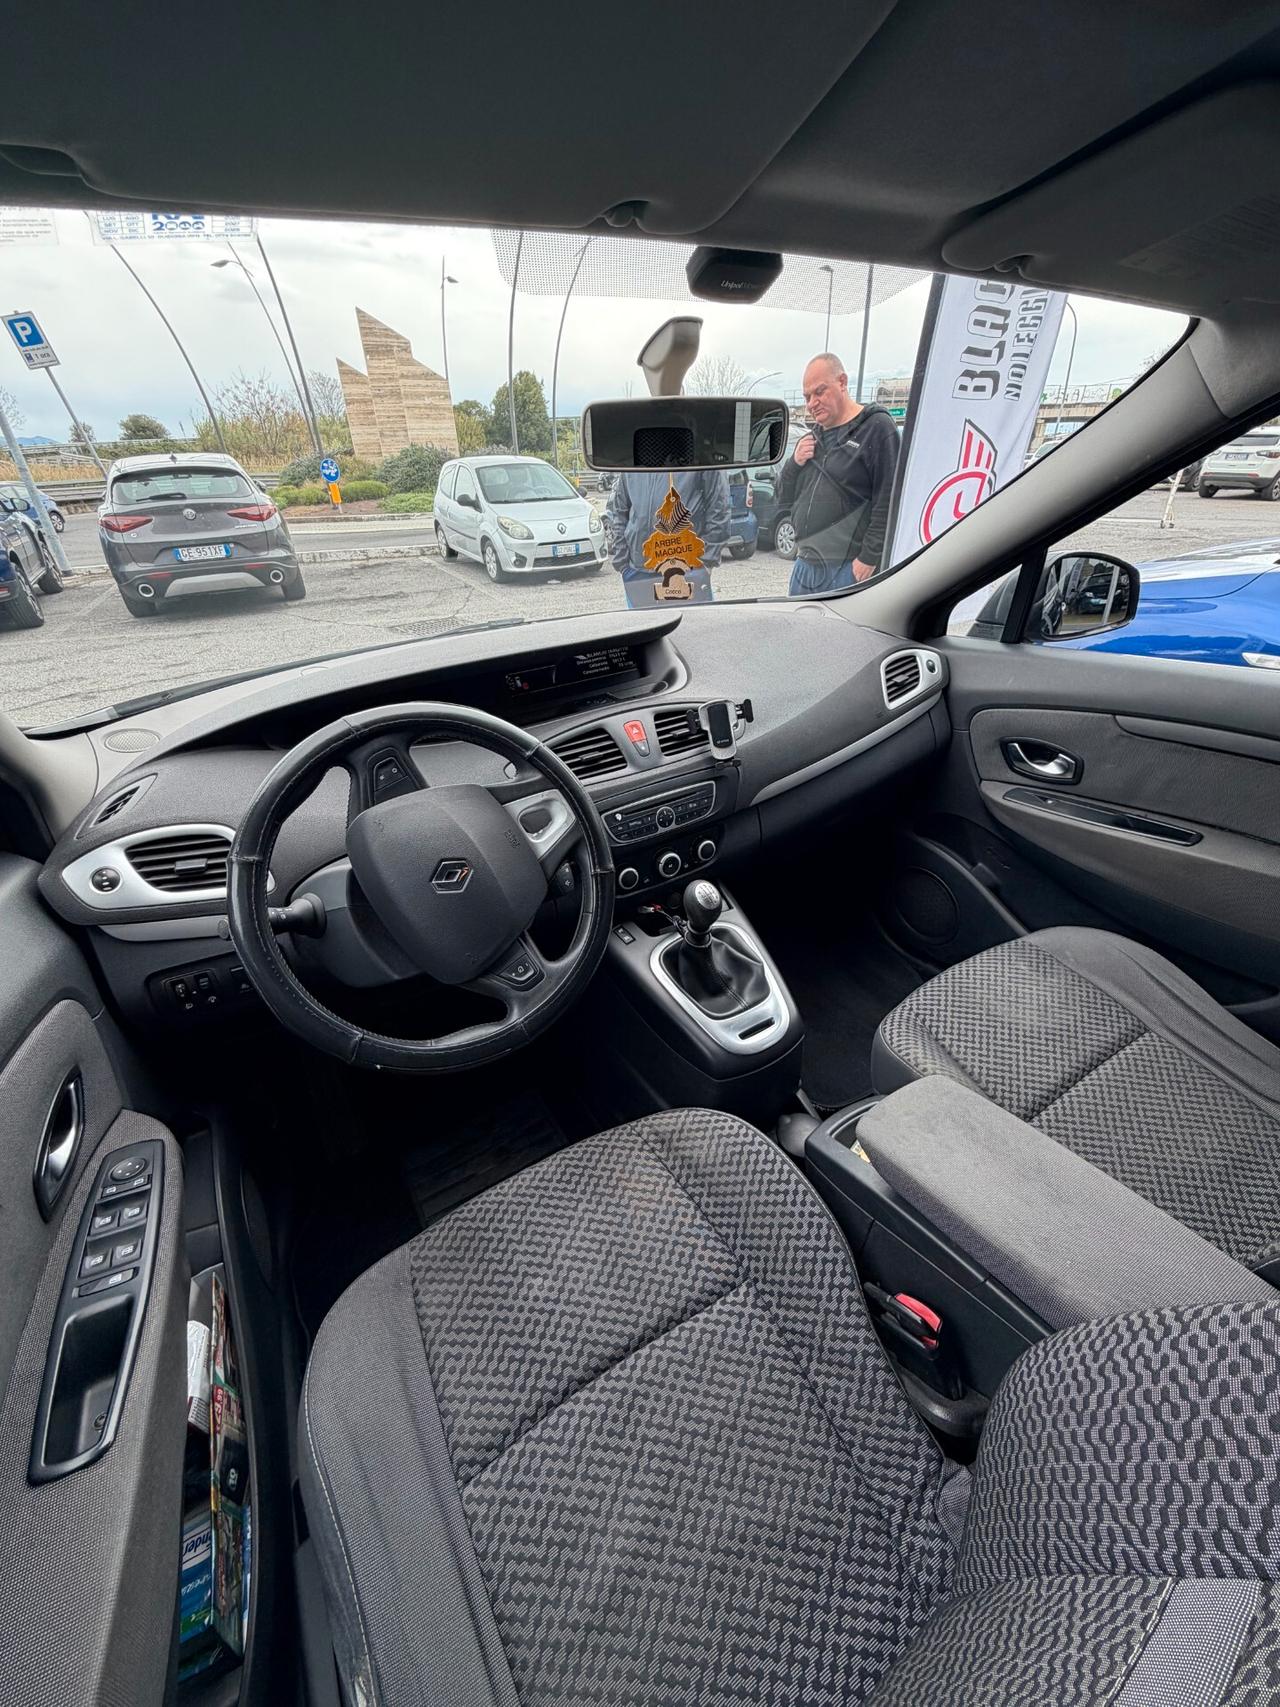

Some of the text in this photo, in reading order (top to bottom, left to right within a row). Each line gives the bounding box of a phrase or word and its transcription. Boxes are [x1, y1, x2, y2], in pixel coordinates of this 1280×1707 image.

[13, 321, 32, 343] P
[654, 537, 682, 549] ARBRE
[655, 544, 693, 558] MAGIQUE
[183, 1531, 211, 1556] nder
